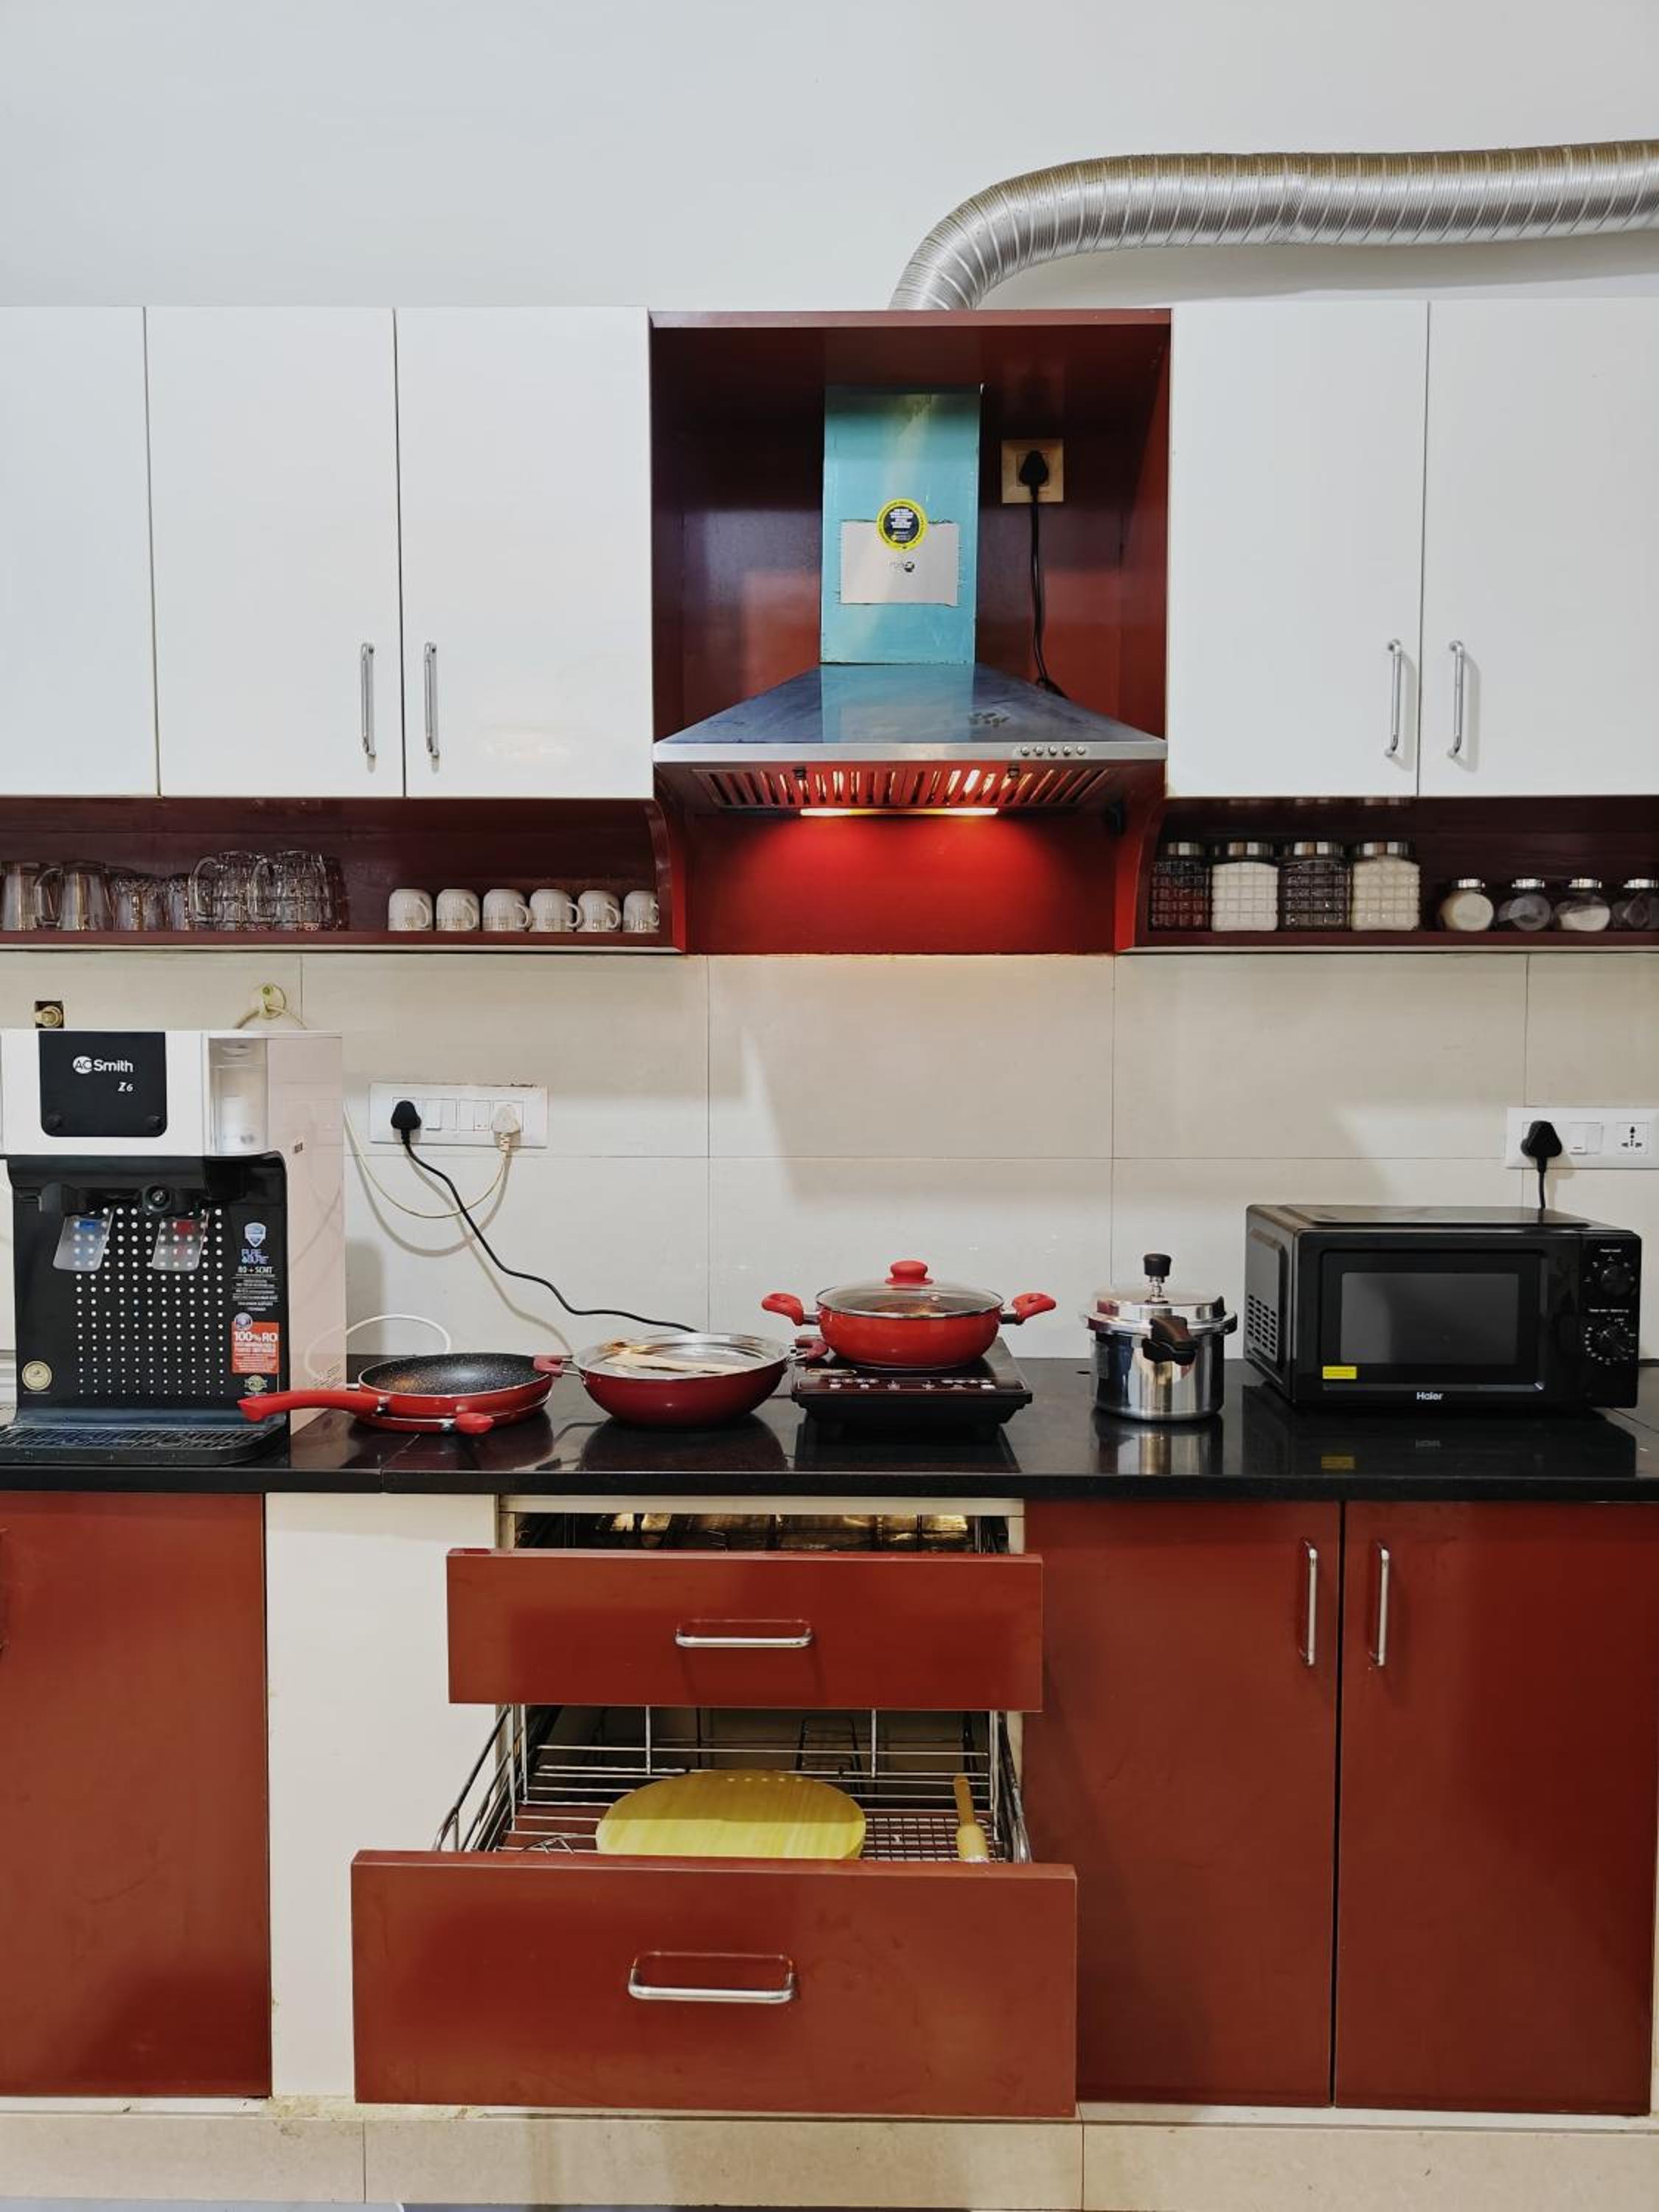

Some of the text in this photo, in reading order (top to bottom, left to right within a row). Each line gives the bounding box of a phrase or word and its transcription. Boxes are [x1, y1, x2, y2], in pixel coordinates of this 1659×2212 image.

[94, 1060, 133, 1073] Smith
[117, 1082, 134, 1091] Z6
[234, 1331, 278, 1343] 100% RO
[1416, 1391, 1444, 1401] Haier
